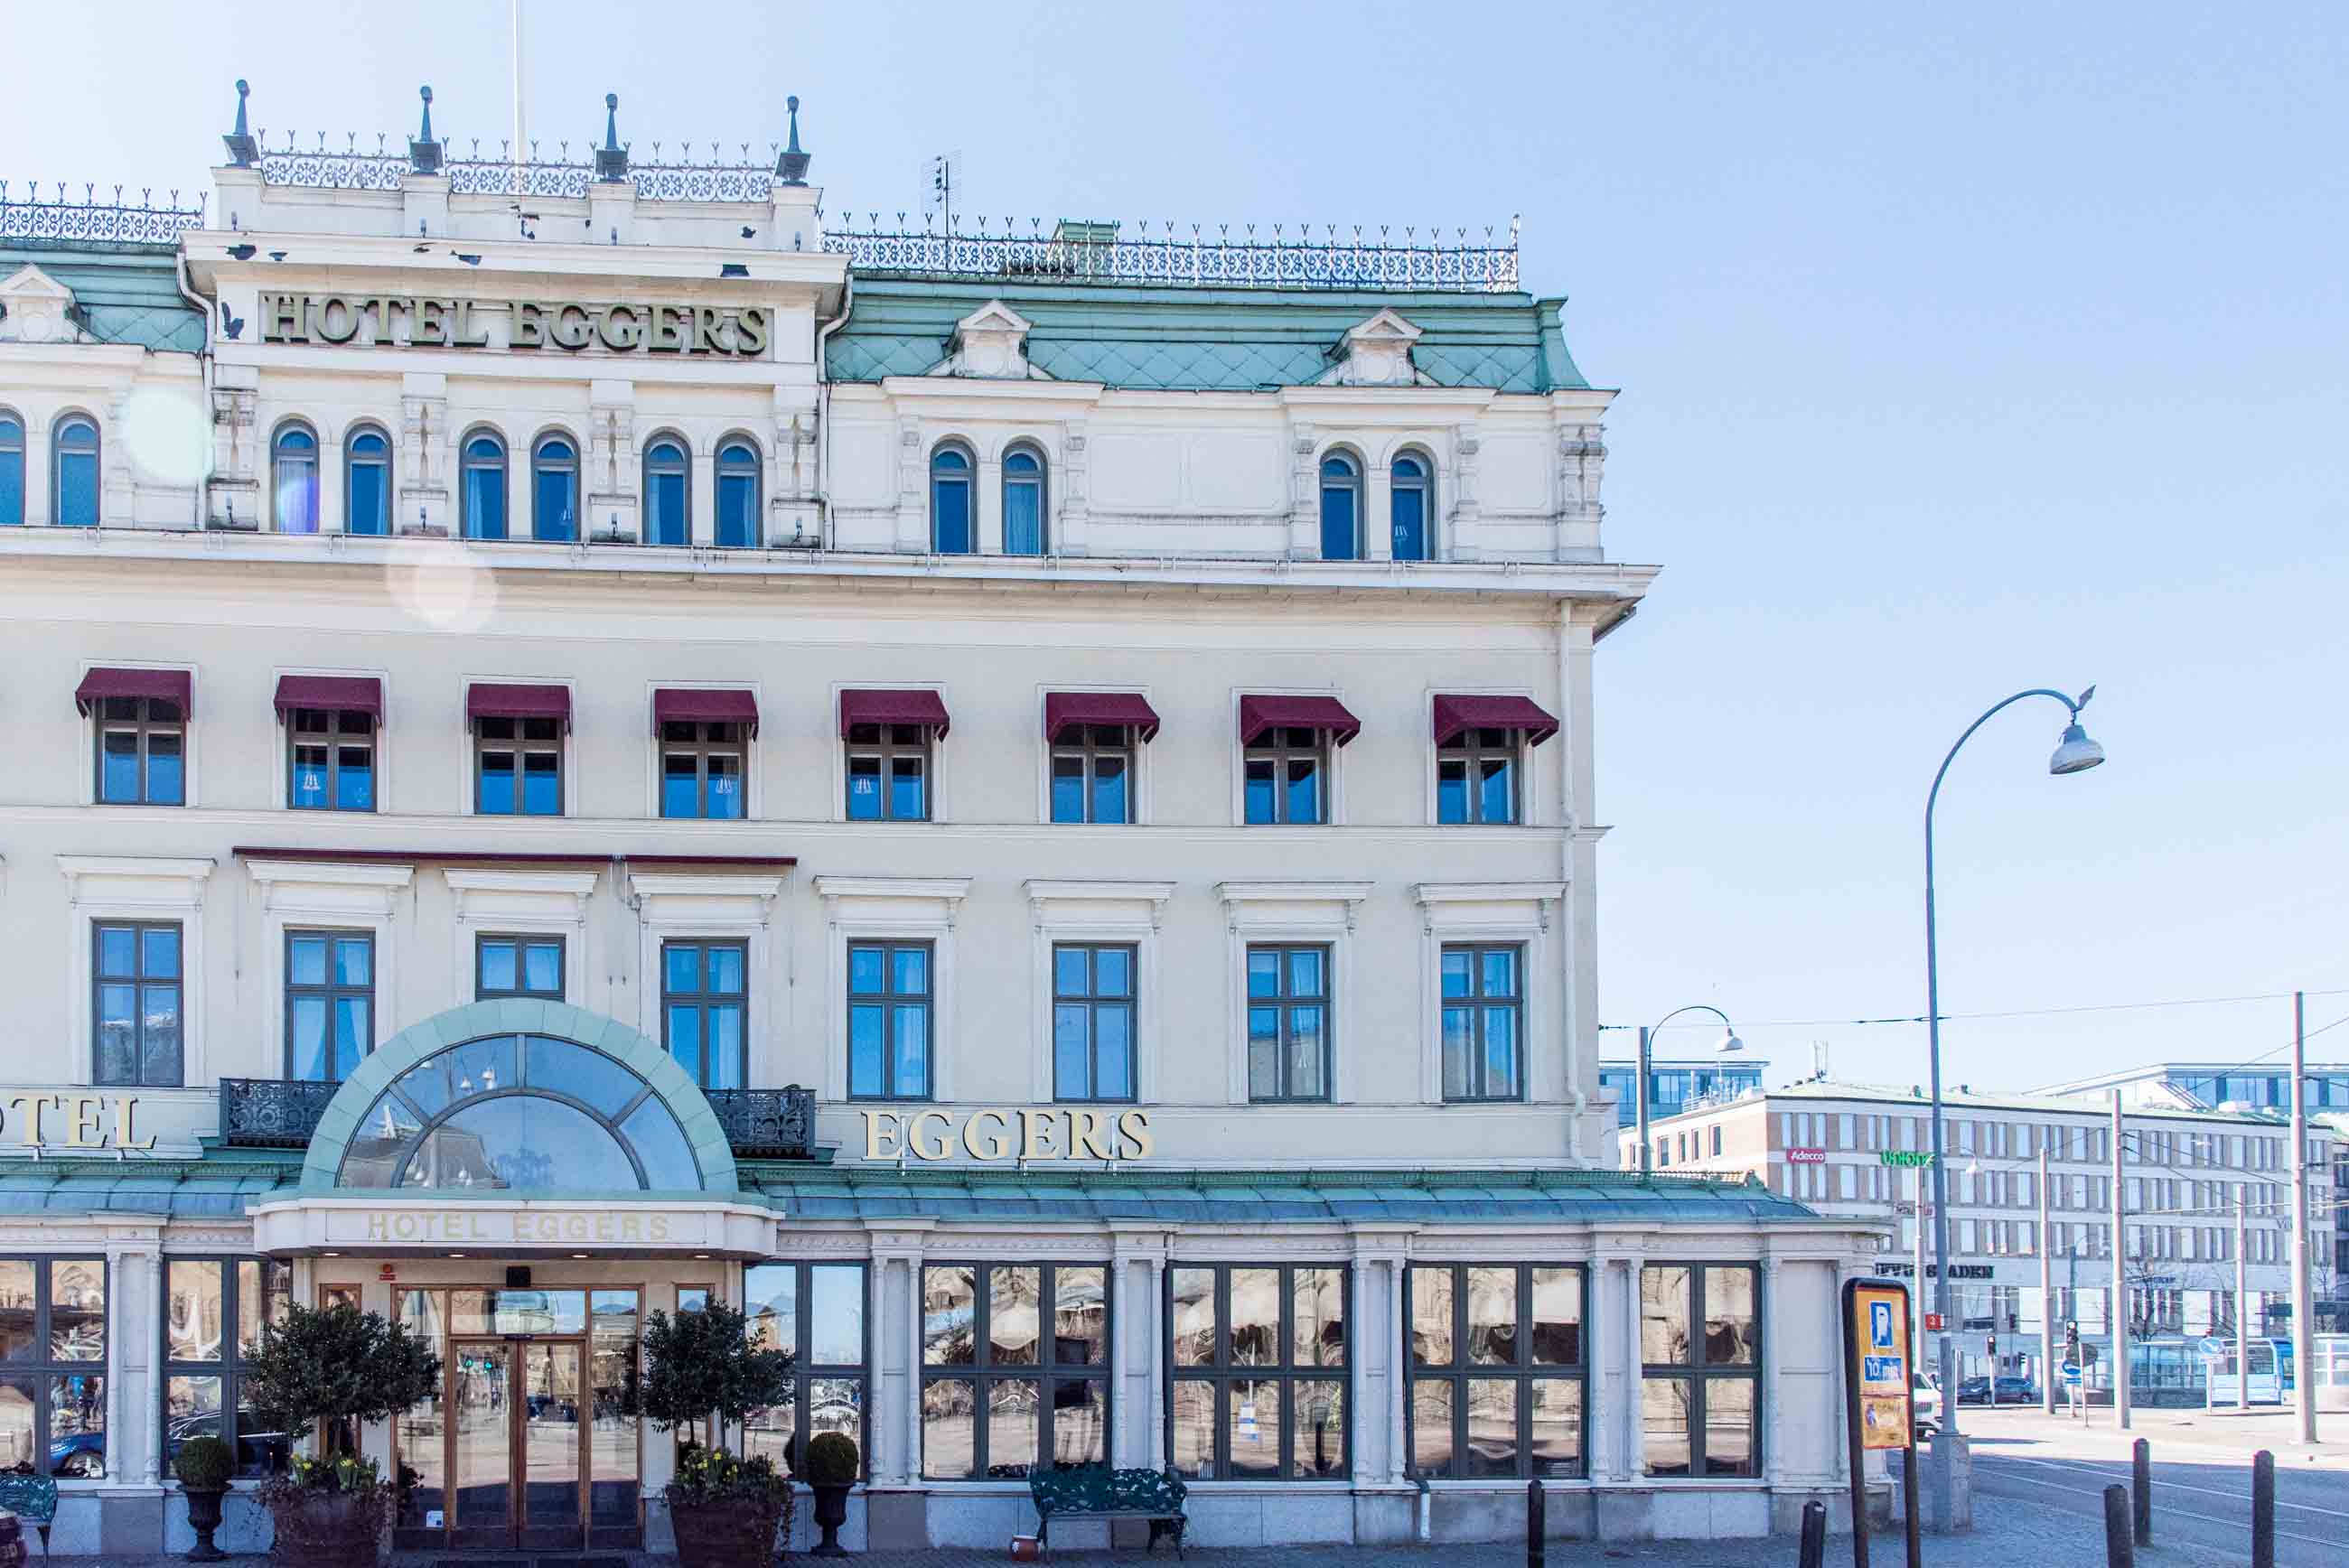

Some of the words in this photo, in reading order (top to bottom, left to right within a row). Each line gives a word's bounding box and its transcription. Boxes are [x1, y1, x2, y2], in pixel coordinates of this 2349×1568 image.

[265, 295, 488, 347] HOTEL
[508, 301, 769, 356] EGGERS
[0, 1097, 157, 1149] TEL
[861, 1109, 1154, 1162] EGGERS
[1791, 1150, 1825, 1161] Adecco
[1881, 1149, 1935, 1167] Union
[368, 1213, 490, 1240] HOTEL
[514, 1214, 670, 1241] EGGERS
